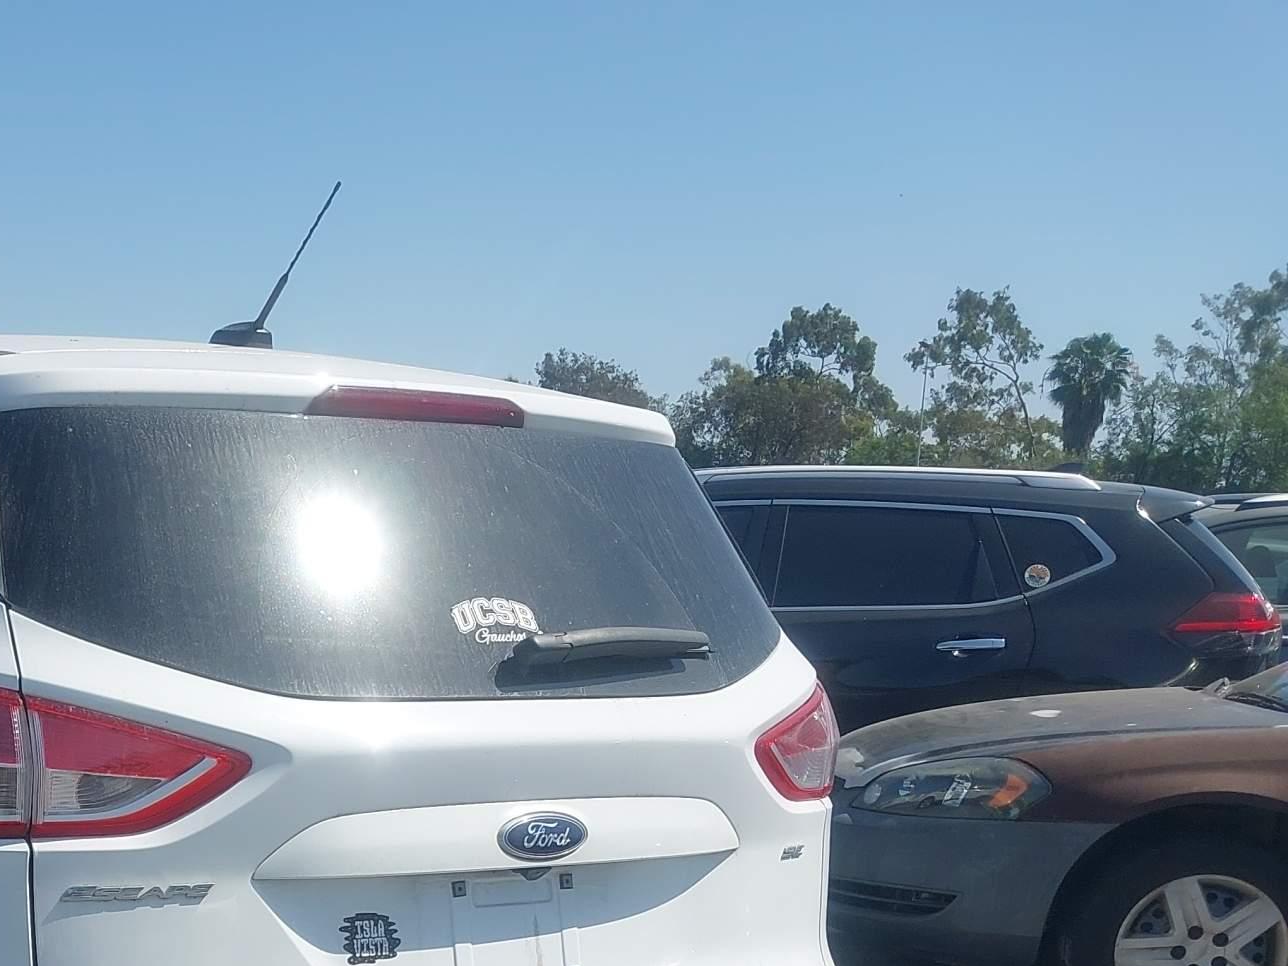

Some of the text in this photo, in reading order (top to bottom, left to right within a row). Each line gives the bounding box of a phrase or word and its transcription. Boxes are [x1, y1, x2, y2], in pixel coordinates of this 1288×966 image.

[450, 597, 539, 634] UCSB
[523, 821, 571, 849] Ford
[354, 920, 386, 938] ISLA
[353, 937, 390, 957] VISTA
